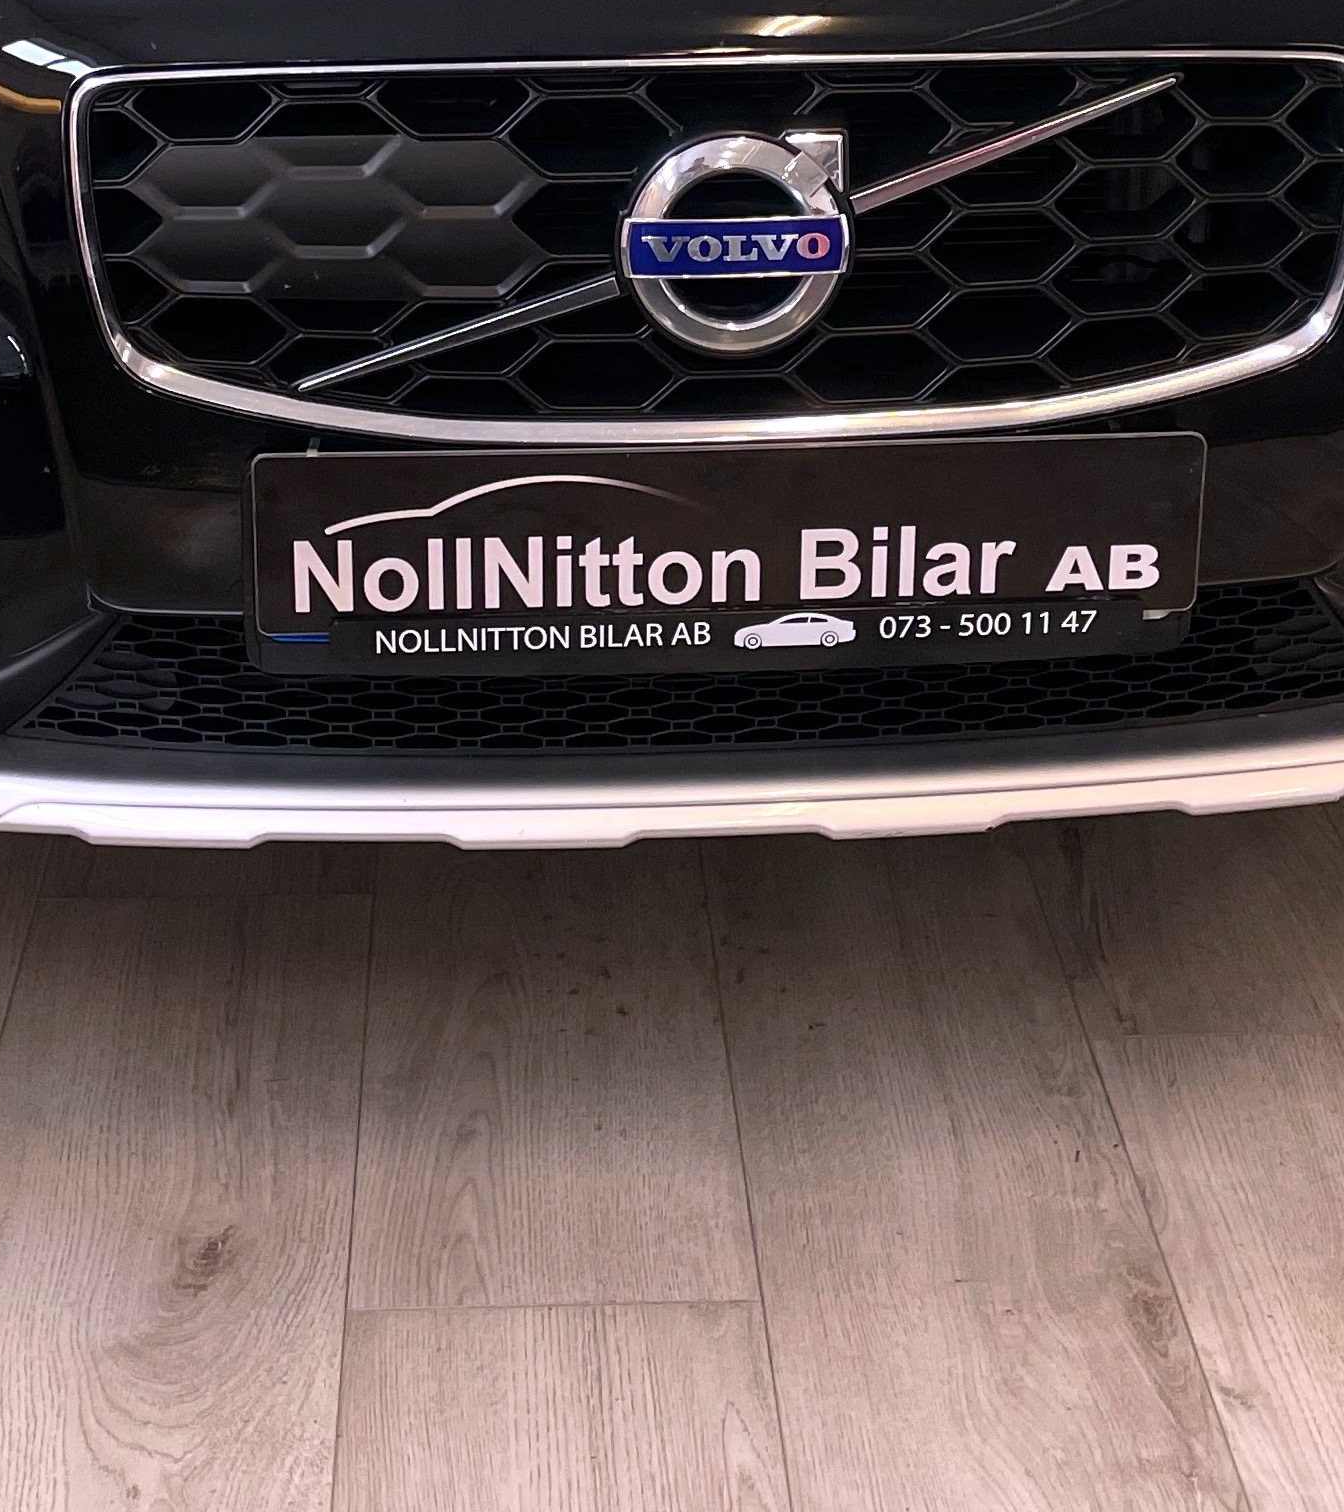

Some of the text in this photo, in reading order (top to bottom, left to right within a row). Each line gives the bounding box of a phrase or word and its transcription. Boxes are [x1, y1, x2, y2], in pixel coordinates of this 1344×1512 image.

[641, 232, 831, 263] VOLVO
[293, 525, 1160, 613] NollNitton Bilar AB
[375, 622, 711, 654] NOLLNITTON BILAR AB
[879, 615, 931, 638] 073
[958, 612, 1011, 636] 500
[1021, 611, 1049, 635] 11
[1061, 610, 1097, 633] 47
